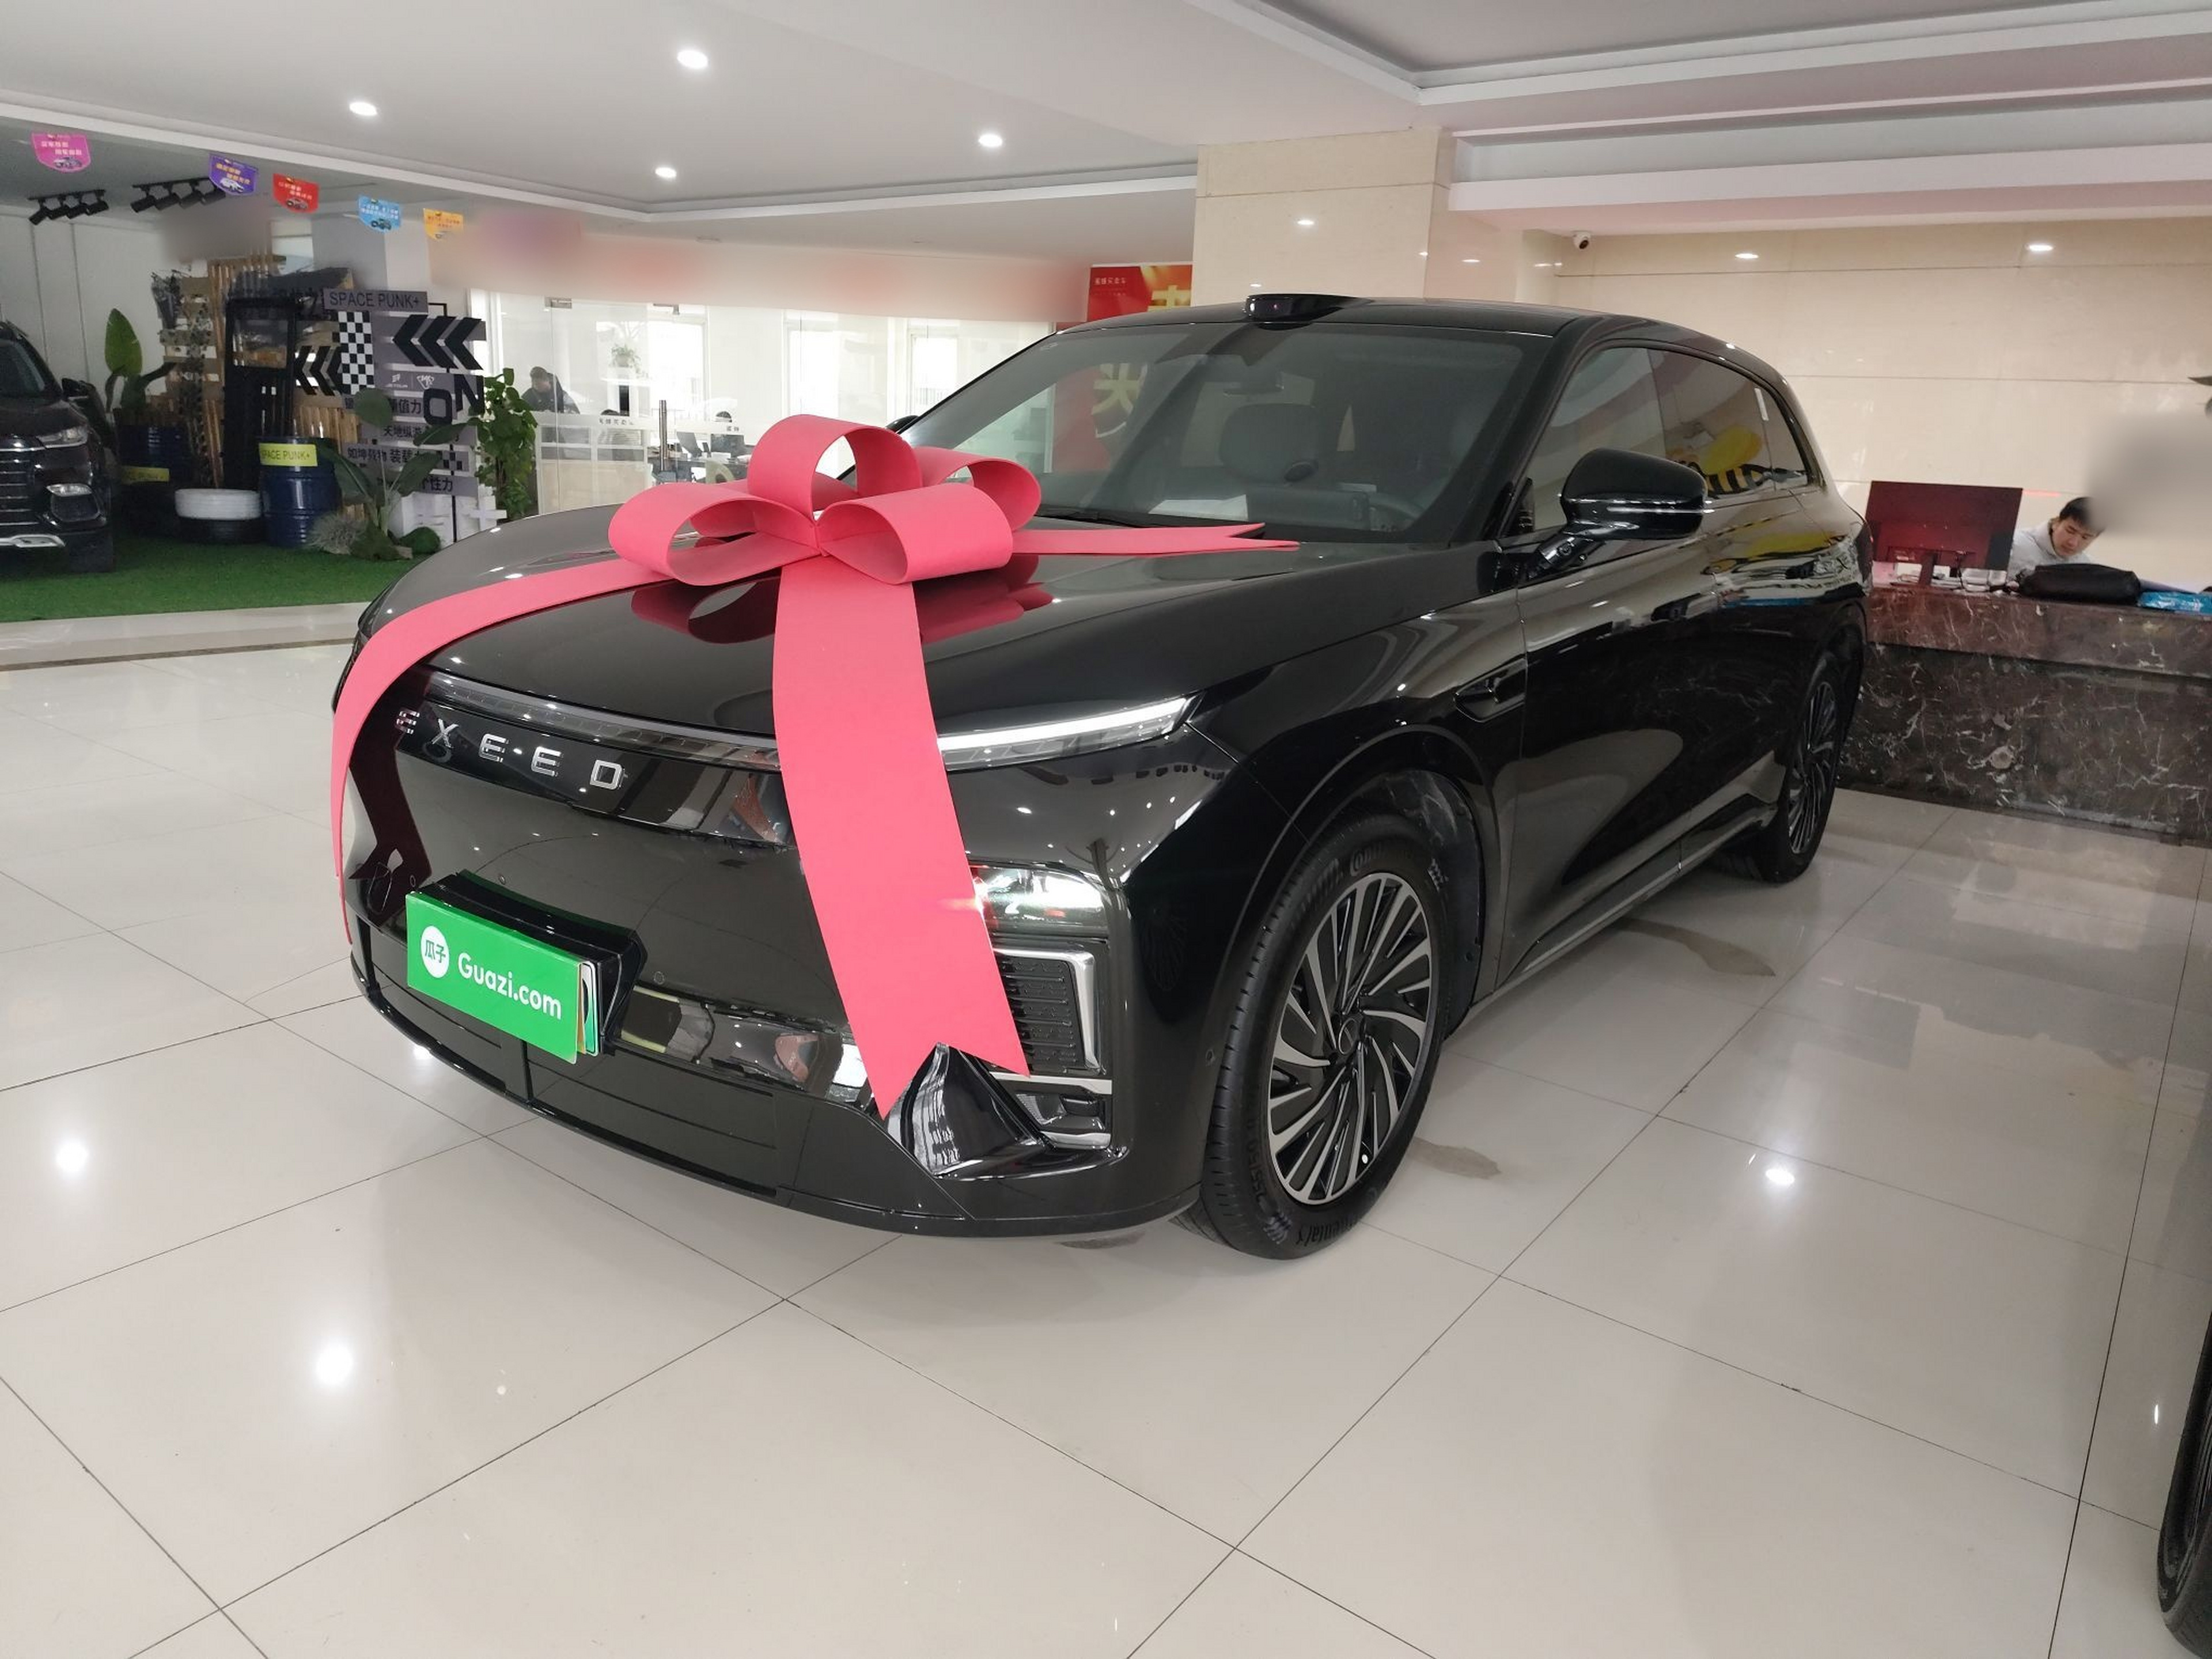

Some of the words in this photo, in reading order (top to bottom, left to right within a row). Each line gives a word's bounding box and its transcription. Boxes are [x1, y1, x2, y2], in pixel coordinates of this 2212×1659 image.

[329, 291, 374, 307] SPACE
[378, 293, 419, 309] PUNK+
[260, 449, 281, 460] PACE
[396, 709, 626, 791] EXEED
[425, 940, 446, 964] 瓜子
[458, 952, 562, 1020] Guazi.com
